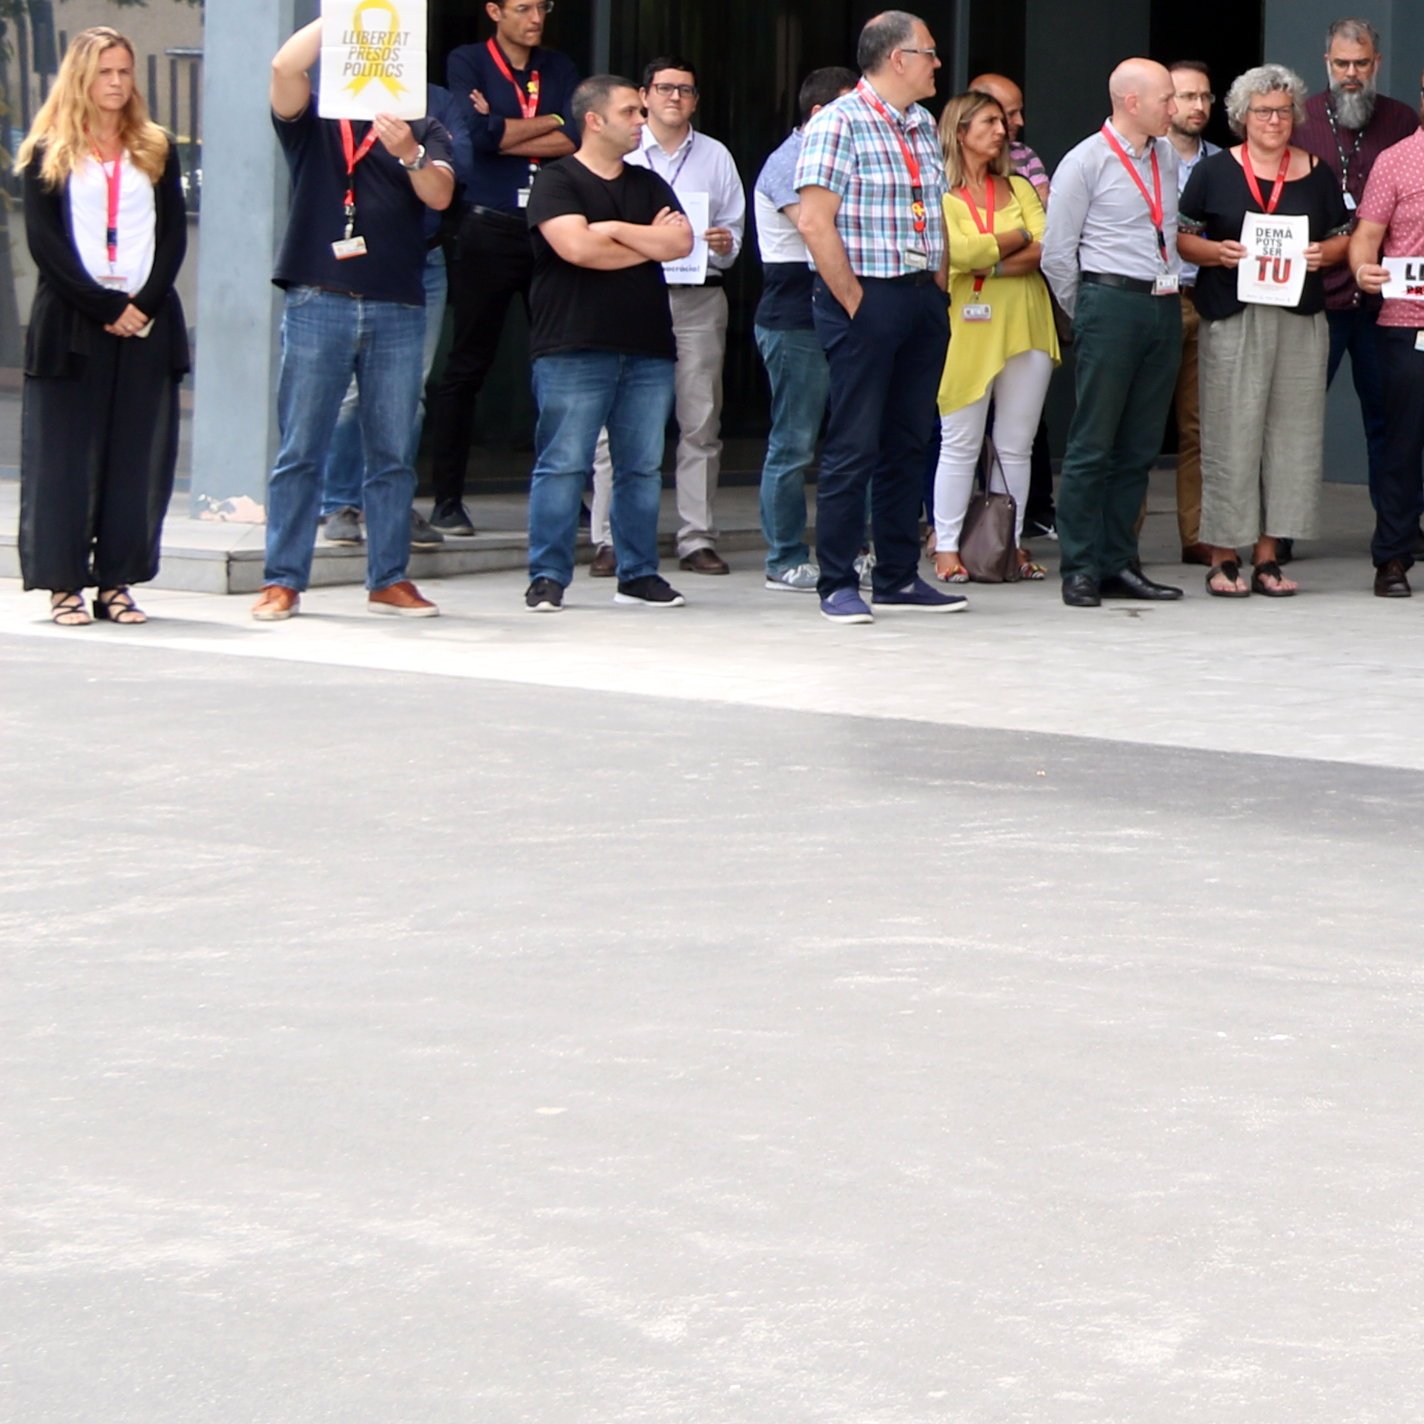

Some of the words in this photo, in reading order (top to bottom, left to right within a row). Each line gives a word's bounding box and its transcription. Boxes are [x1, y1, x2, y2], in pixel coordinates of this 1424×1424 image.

[342, 30, 410, 46] LLIBERTAT
[347, 46, 400, 61] PRESOS
[1256, 226, 1293, 239] DEMÀ
[1256, 238, 1282, 247] POTS
[1263, 247, 1282, 256] SER
[1255, 256, 1291, 284] TU
